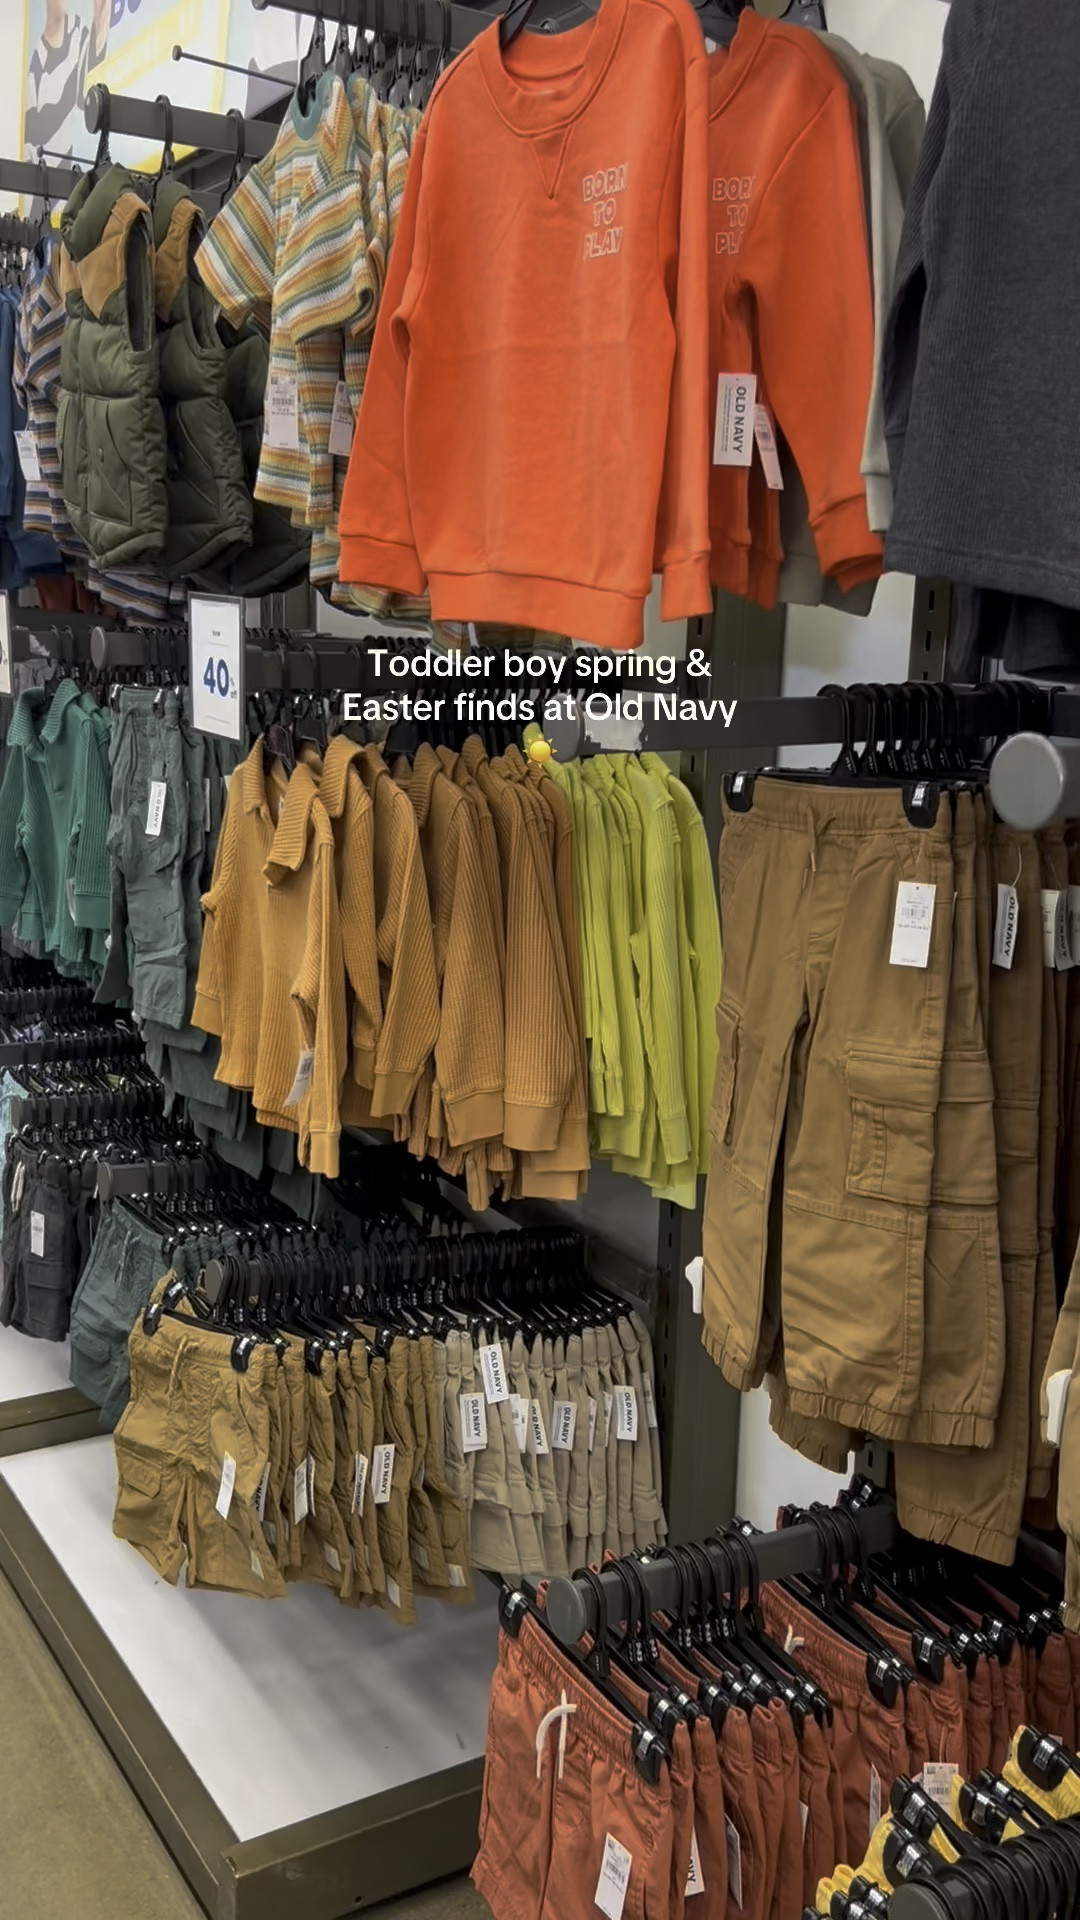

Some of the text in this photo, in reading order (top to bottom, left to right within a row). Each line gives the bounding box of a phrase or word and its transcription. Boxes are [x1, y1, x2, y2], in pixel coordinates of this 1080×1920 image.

[583, 163, 627, 201] BORN
[713, 176, 756, 201] BOR
[593, 198, 616, 227] TO
[727, 204, 748, 227] TO
[584, 226, 623, 260] PLAY
[733, 386, 747, 454] OLD NAVY
[203, 656, 230, 697] 40
[1004, 896, 1015, 957] OLD NAVY
[490, 1351, 503, 1394] OLD NAVY
[472, 1399, 481, 1437] OLD NAVY
[533, 1423, 543, 1447] NAVY
[561, 1423, 569, 1444] NAVY
[381, 1470, 389, 1494] NAVY
